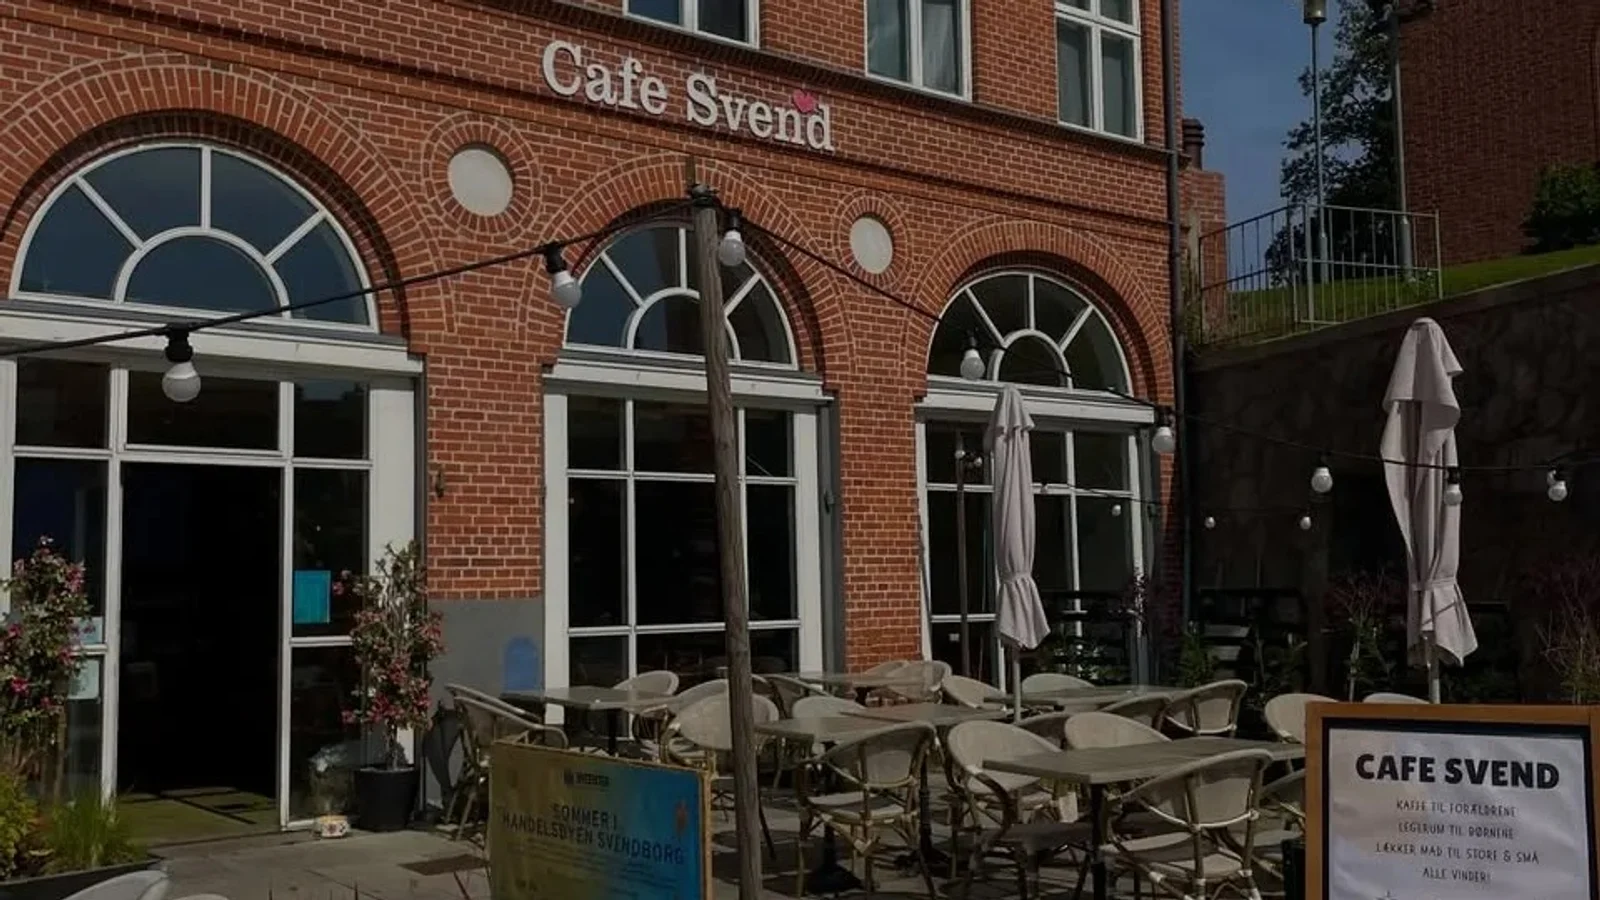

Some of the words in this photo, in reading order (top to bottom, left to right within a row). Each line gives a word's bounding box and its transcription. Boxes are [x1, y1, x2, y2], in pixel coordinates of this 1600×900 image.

[542, 41, 667, 115] Cafe
[687, 73, 835, 152] Svend
[1355, 754, 1437, 783] CAFE
[1444, 758, 1560, 790] SVEND
[553, 803, 611, 828] SOMMER
[1396, 799, 1427, 812] KAFFE
[1431, 801, 1446, 812] TIL
[1449, 802, 1516, 818] FORÆLDRENE
[502, 811, 593, 844] HANDELSBYEN
[598, 831, 685, 865] SVENDBORG
[1398, 822, 1445, 835] LEGERUM
[1449, 824, 1463, 837] TIL
[1468, 826, 1514, 840] BØRNENE
[1376, 842, 1417, 856] LÆKKER
[1420, 844, 1443, 857] MAD
[1447, 846, 1461, 859] TIL
[1466, 848, 1498, 861] STORE
[1503, 849, 1512, 862] &
[1516, 851, 1540, 864] SMÅ
[1422, 867, 1448, 880] ALLE
[1452, 869, 1492, 883] VINDER!
